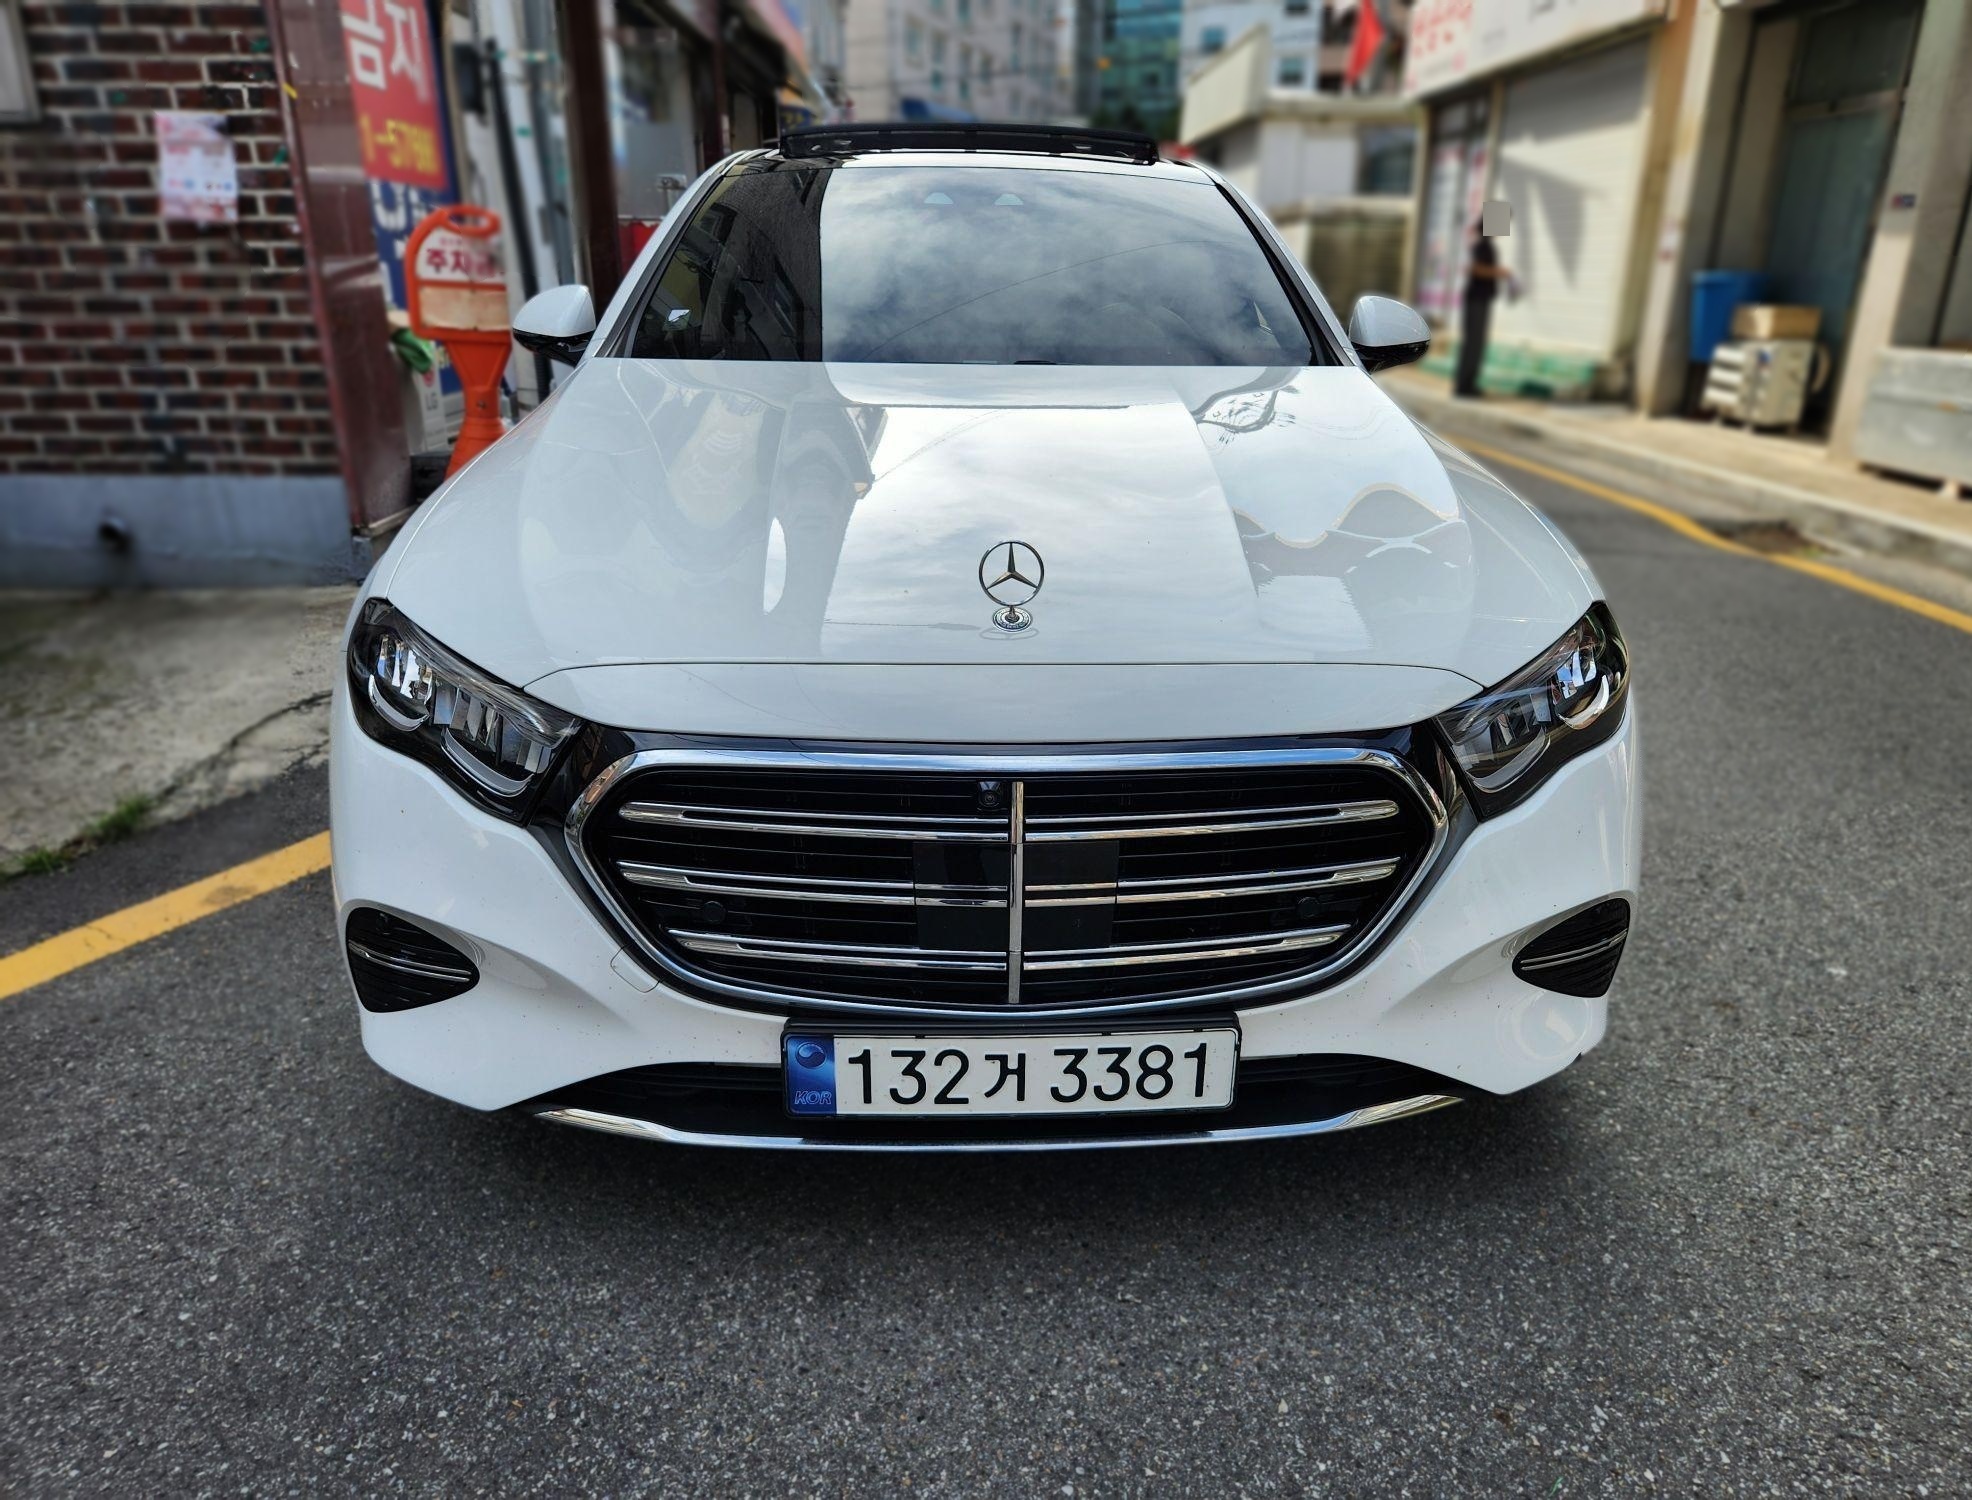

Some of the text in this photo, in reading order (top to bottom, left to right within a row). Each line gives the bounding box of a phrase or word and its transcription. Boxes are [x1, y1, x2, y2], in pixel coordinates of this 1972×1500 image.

[848, 1042, 1208, 1105] 132거 3381
[794, 1090, 832, 1105] KOR
